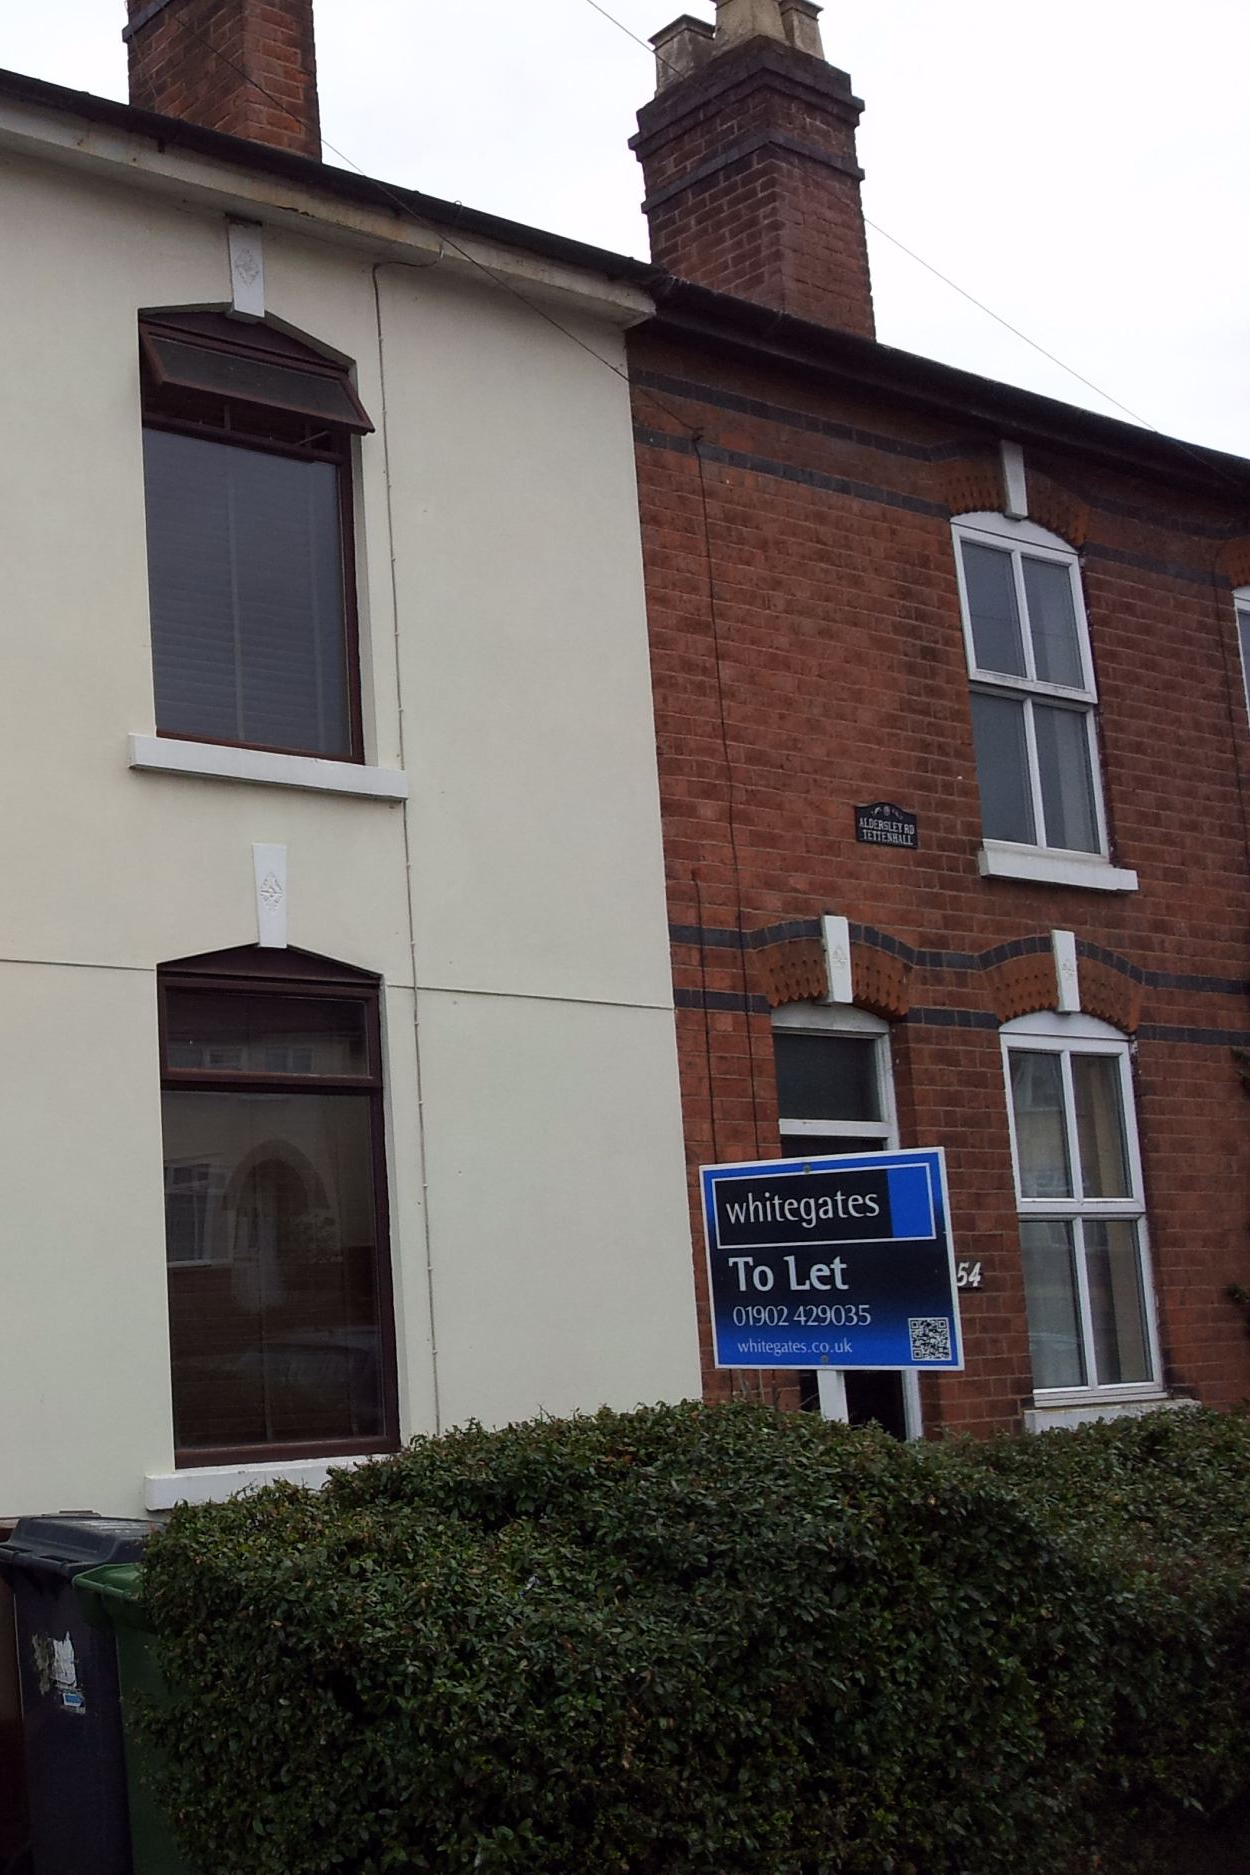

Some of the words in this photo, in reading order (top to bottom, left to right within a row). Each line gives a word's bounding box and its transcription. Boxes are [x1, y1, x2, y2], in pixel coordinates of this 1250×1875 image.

[859, 817, 903, 833] ALDERSLEY
[904, 824, 914, 834] RD
[862, 829, 913, 845] TETTENHALL
[726, 1190, 880, 1228] whitegates
[728, 1257, 774, 1292] To
[783, 1255, 849, 1291] Let
[956, 1261, 981, 1287] 54
[733, 1306, 789, 1326] 01902
[793, 1305, 871, 1326] 429035
[737, 1338, 853, 1357] whitegates.co.uk
